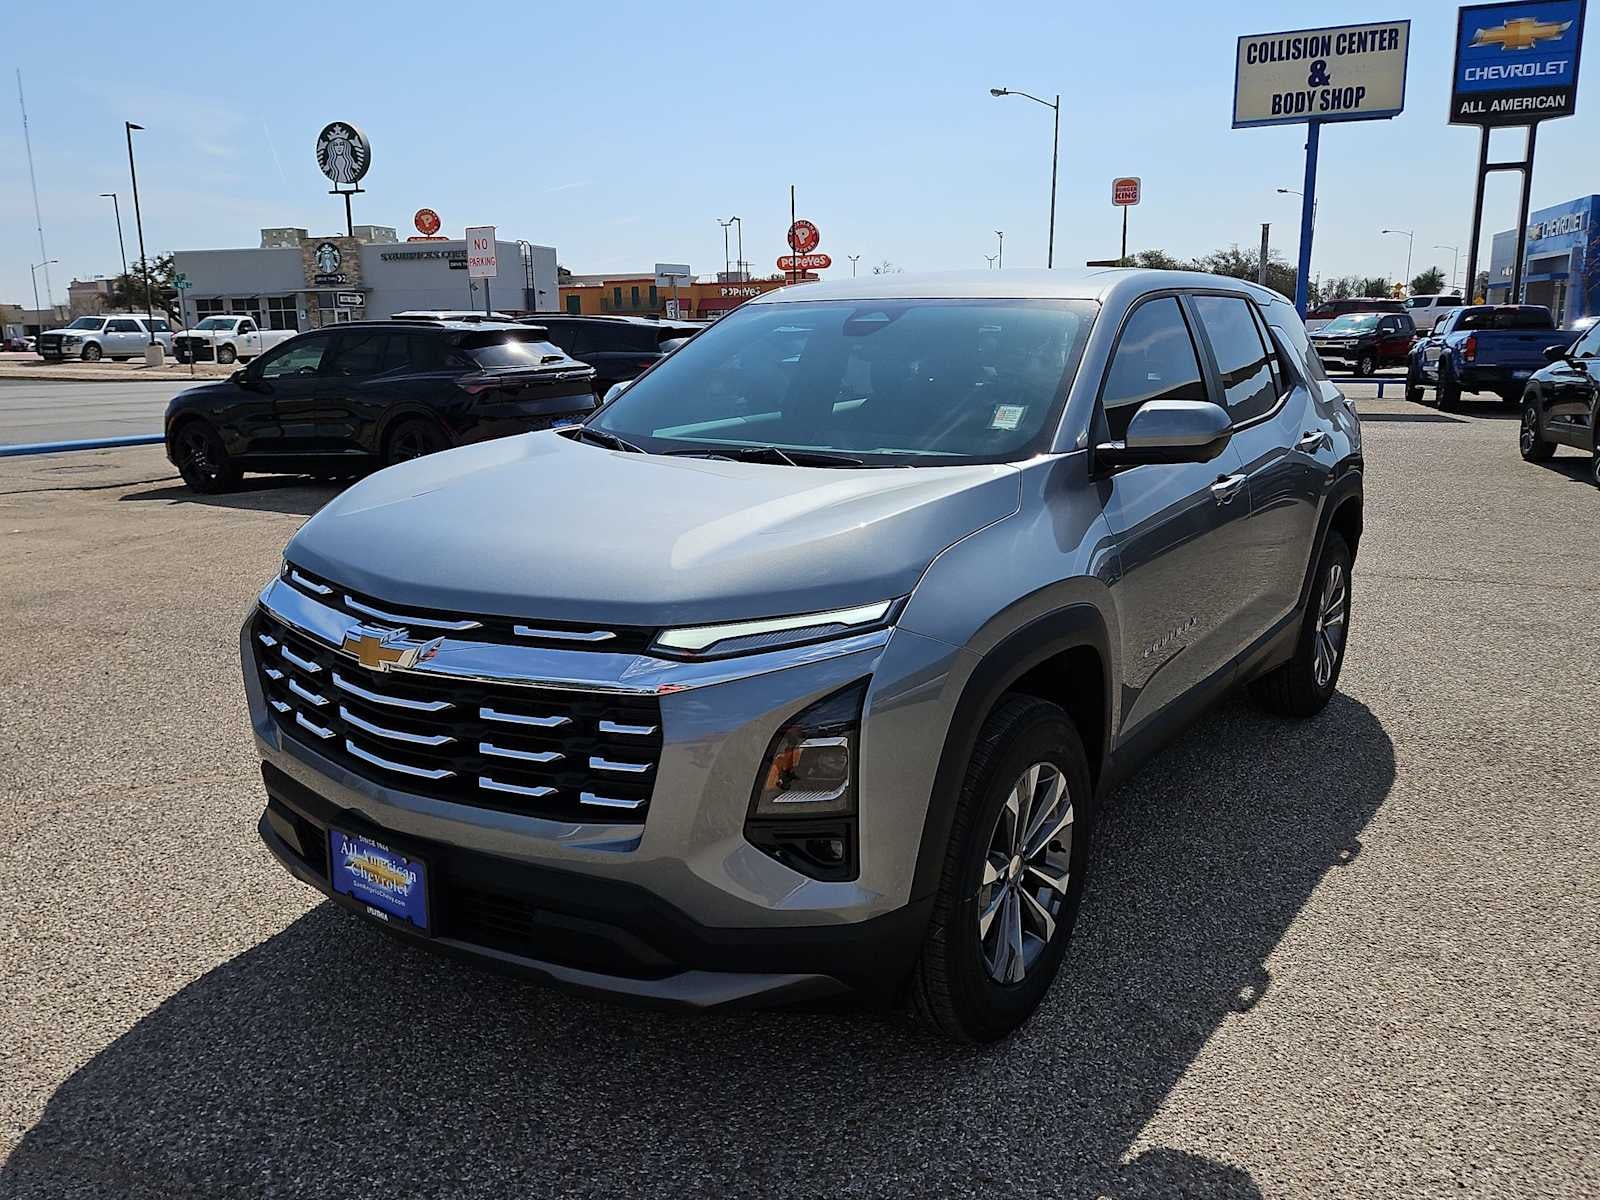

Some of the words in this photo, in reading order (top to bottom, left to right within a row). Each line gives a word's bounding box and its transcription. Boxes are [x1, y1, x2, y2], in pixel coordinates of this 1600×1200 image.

[1246, 35, 1332, 65] COLLISION
[1335, 28, 1399, 55] CENTER
[1307, 59, 1331, 88] &
[1464, 60, 1568, 81] CHEVROLET
[1271, 90, 1317, 115] BODY
[1319, 86, 1366, 111] SHOP
[1460, 101, 1486, 114] ALL
[1490, 95, 1566, 112] AMERICAN
[1115, 191, 1137, 200] KING
[1541, 212, 1585, 238] CHEVROLET
[474, 238, 488, 250] NO
[469, 256, 496, 267] PARKING
[340, 841, 357, 858] All
[360, 849, 417, 883] American
[351, 862, 409, 896] Chevrolet
